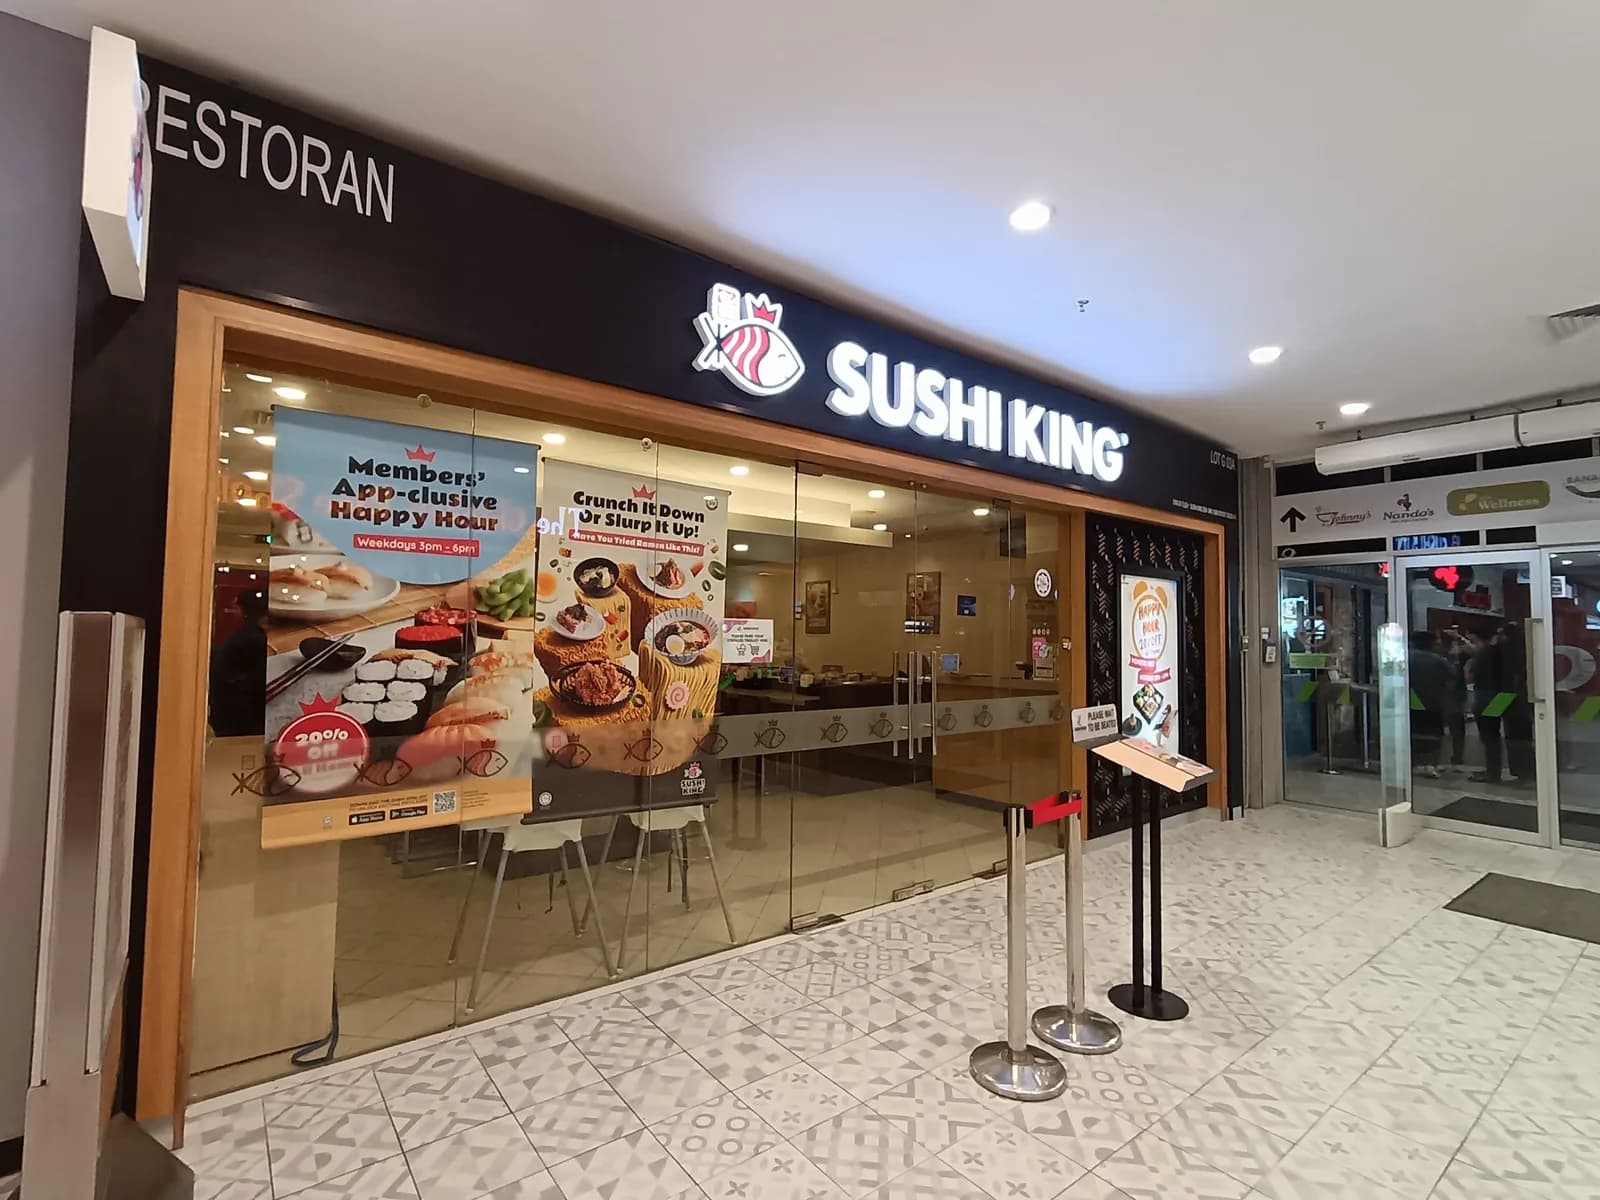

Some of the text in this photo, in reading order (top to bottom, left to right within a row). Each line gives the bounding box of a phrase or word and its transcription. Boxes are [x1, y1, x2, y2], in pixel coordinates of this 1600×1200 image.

[827, 341, 1124, 482] SUSHI KING
[332, 478, 497, 510] App-clusive
[573, 491, 704, 523] Crunch It Down
[1478, 498, 1540, 511] Wellness
[330, 501, 499, 531] Happy Hour
[579, 509, 699, 539] Or Slurp It Up!
[1383, 508, 1434, 521] Nando's
[357, 537, 417, 551] Weekdays
[419, 541, 443, 554] 3pm
[452, 544, 476, 555] 6pm
[598, 533, 613, 544] You
[614, 537, 635, 547] Tried
[637, 539, 665, 550] Ramen
[666, 543, 681, 552] Like
[1088, 711, 1104, 720] PLEASE
[295, 728, 348, 747] 20%
[681, 779, 705, 788] SUSHI
[682, 787, 703, 795] KING
